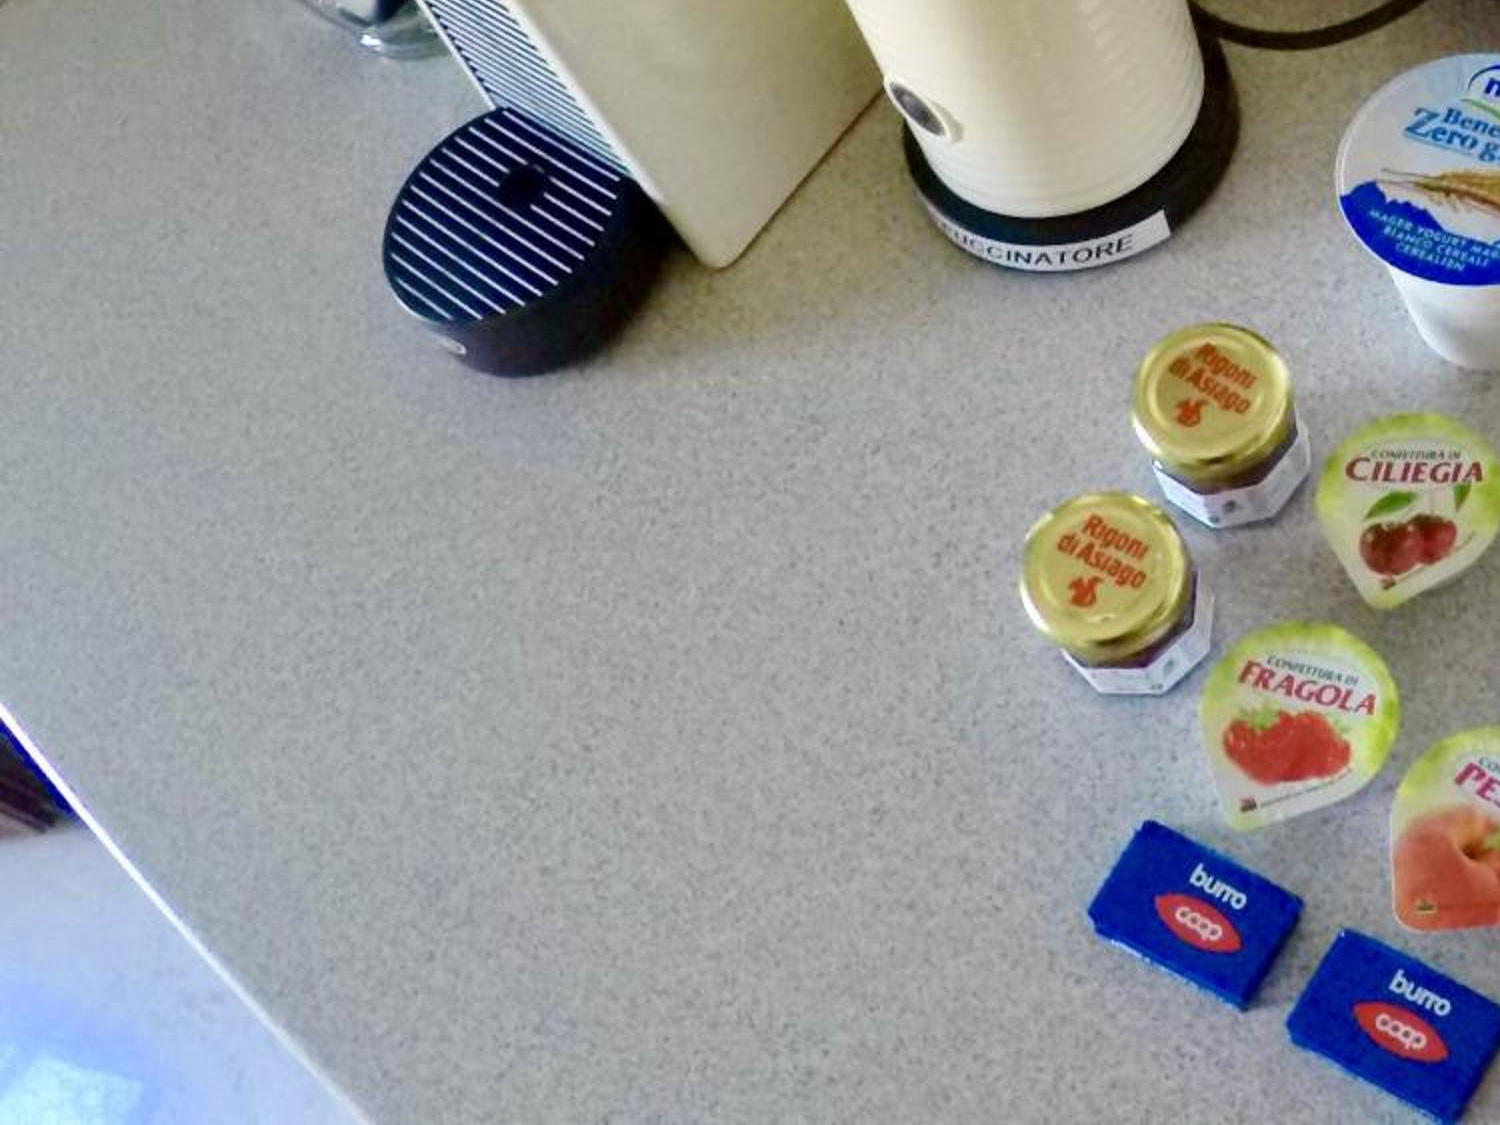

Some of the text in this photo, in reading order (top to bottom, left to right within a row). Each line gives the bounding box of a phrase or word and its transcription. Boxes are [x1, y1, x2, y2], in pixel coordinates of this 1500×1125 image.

[1403, 107, 1478, 154] Zero
[1417, 226, 1468, 248] YOGURT
[1168, 355, 1252, 415] di Asiago
[1194, 341, 1258, 390] Rigoni
[1344, 456, 1484, 484] CILIEGIA
[1370, 449, 1462, 461] CONFETTURA DI
[1081, 513, 1150, 559] Rigoni
[1057, 533, 1148, 590] di Asiago
[1237, 658, 1378, 717] FRAGOLA
[1266, 655, 1345, 683] CONFETTURA
[1188, 862, 1248, 911] burro
[1174, 905, 1224, 943] coop
[1387, 968, 1453, 1017] burro
[1374, 1011, 1428, 1051] coop
